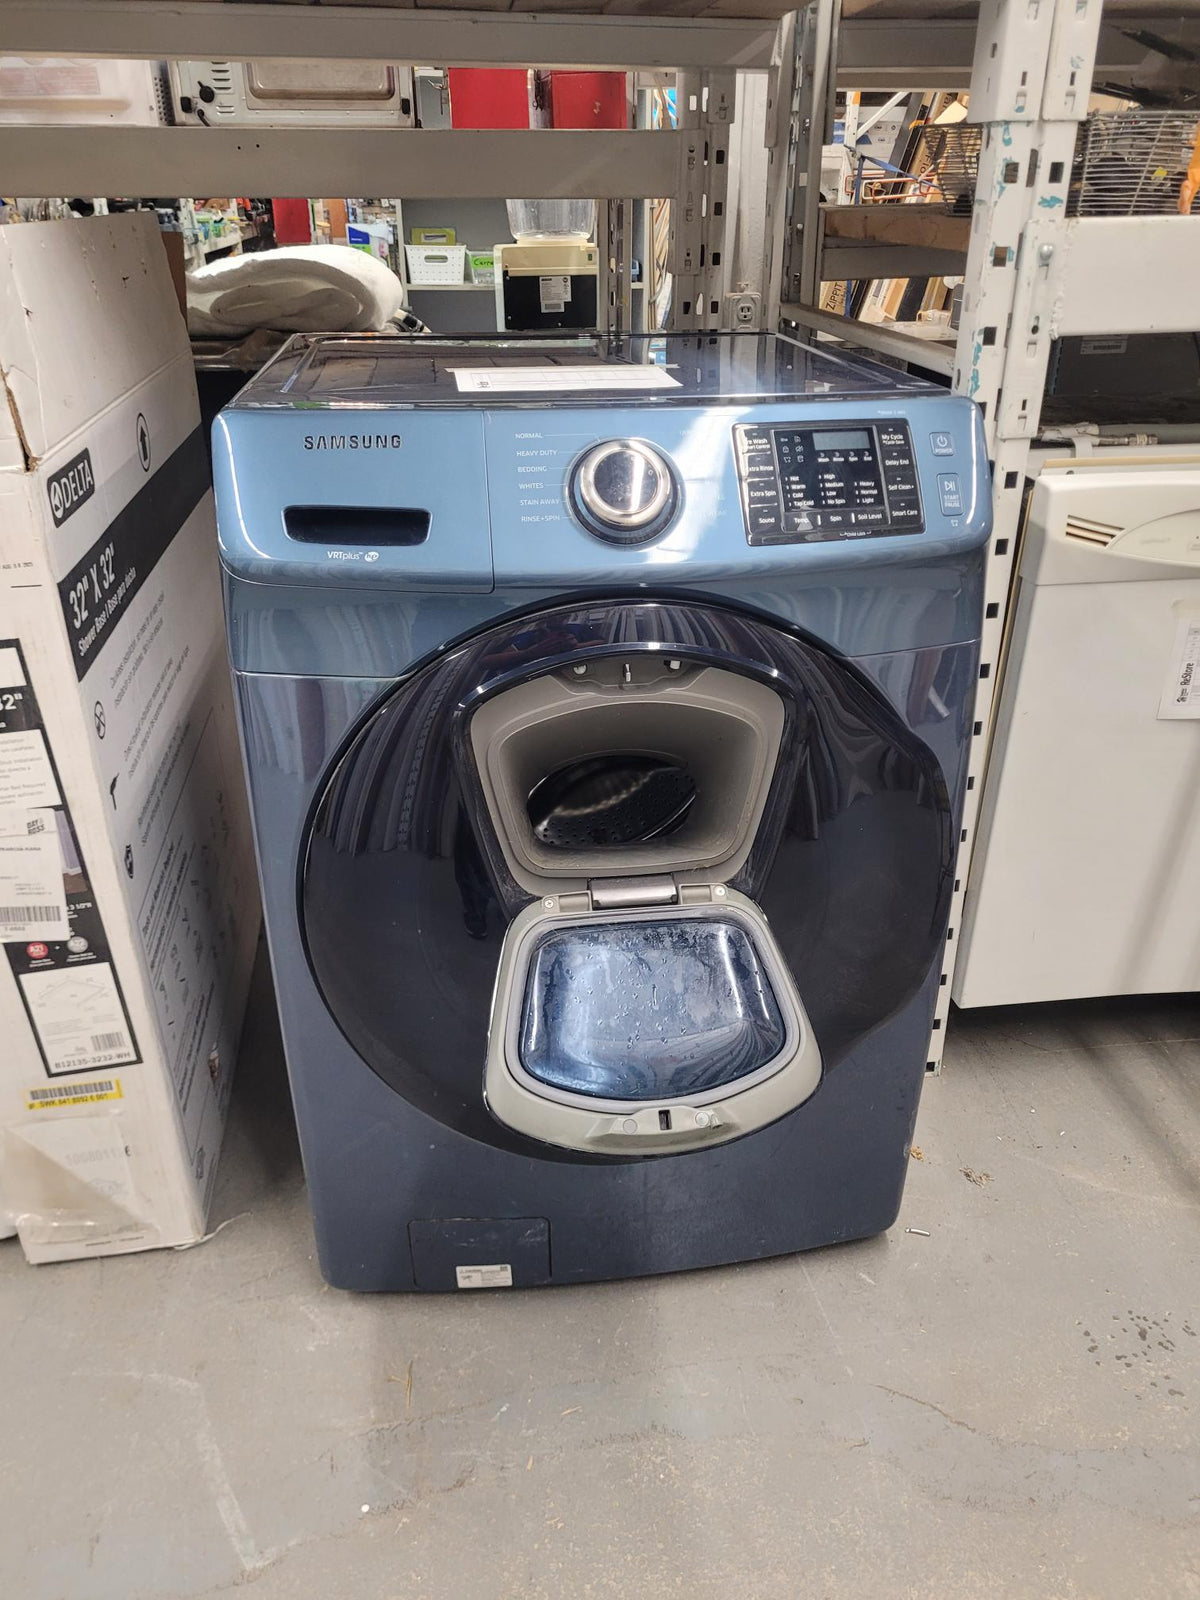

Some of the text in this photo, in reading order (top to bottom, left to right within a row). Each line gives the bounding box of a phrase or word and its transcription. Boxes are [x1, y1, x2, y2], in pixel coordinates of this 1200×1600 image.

[825, 282, 843, 310] ZIPPIT
[304, 434, 402, 450] SAMSUNG
[60, 459, 94, 509] DELTA
[519, 482, 544, 490] WHITES
[892, 509, 907, 517] Smart
[69, 542, 116, 629] 32" X 32"
[78, 625, 98, 657] Shower
[1180, 662, 1195, 686] ReStore
[55, 1052, 130, 1069] B12135-3232-WH
